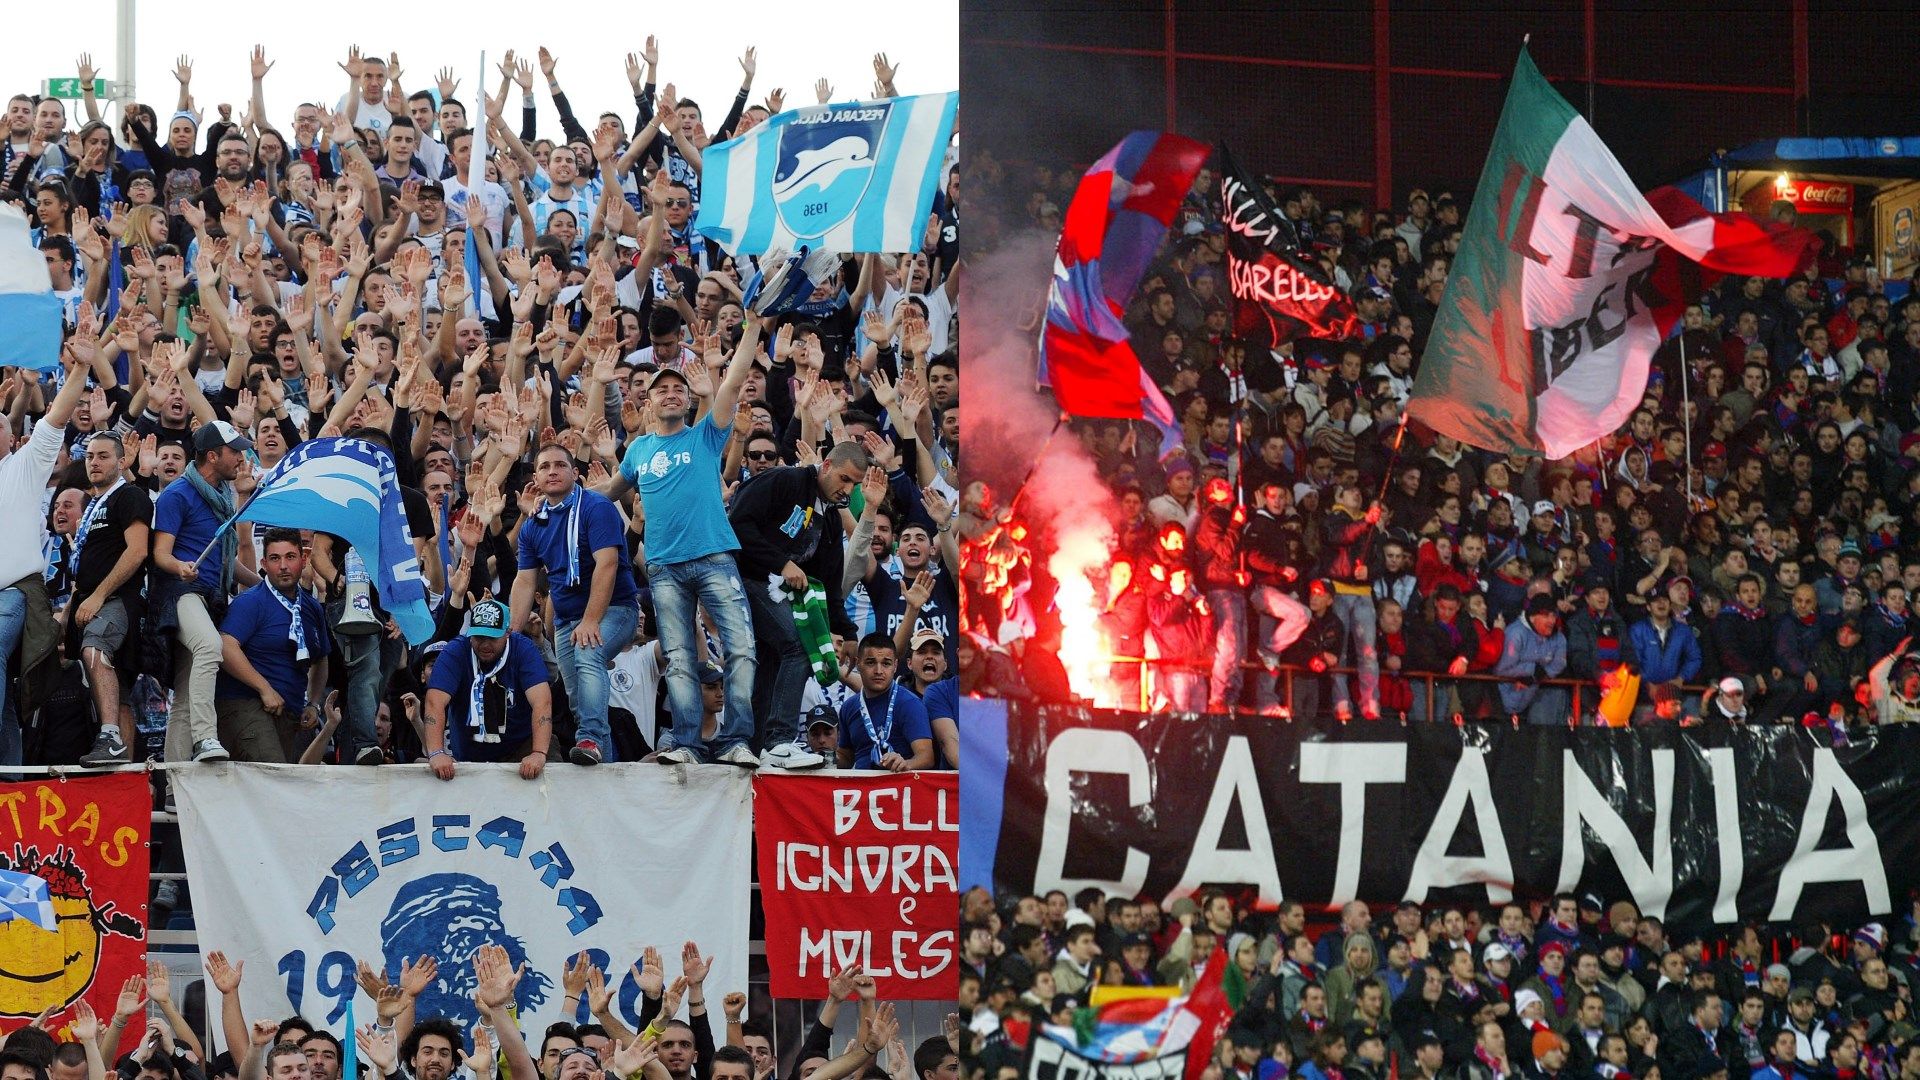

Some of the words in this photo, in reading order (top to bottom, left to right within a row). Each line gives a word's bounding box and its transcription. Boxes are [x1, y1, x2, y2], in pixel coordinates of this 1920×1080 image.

[673, 451, 691, 466] 76
[0, 785, 139, 867] TRAS
[1034, 727, 1892, 923] CATANIA
[306, 814, 604, 936] PESCARA
[777, 841, 959, 894] IGNORA
[899, 896, 917, 925] e
[799, 927, 955, 979] MOLES
[278, 949, 357, 1026] 19
